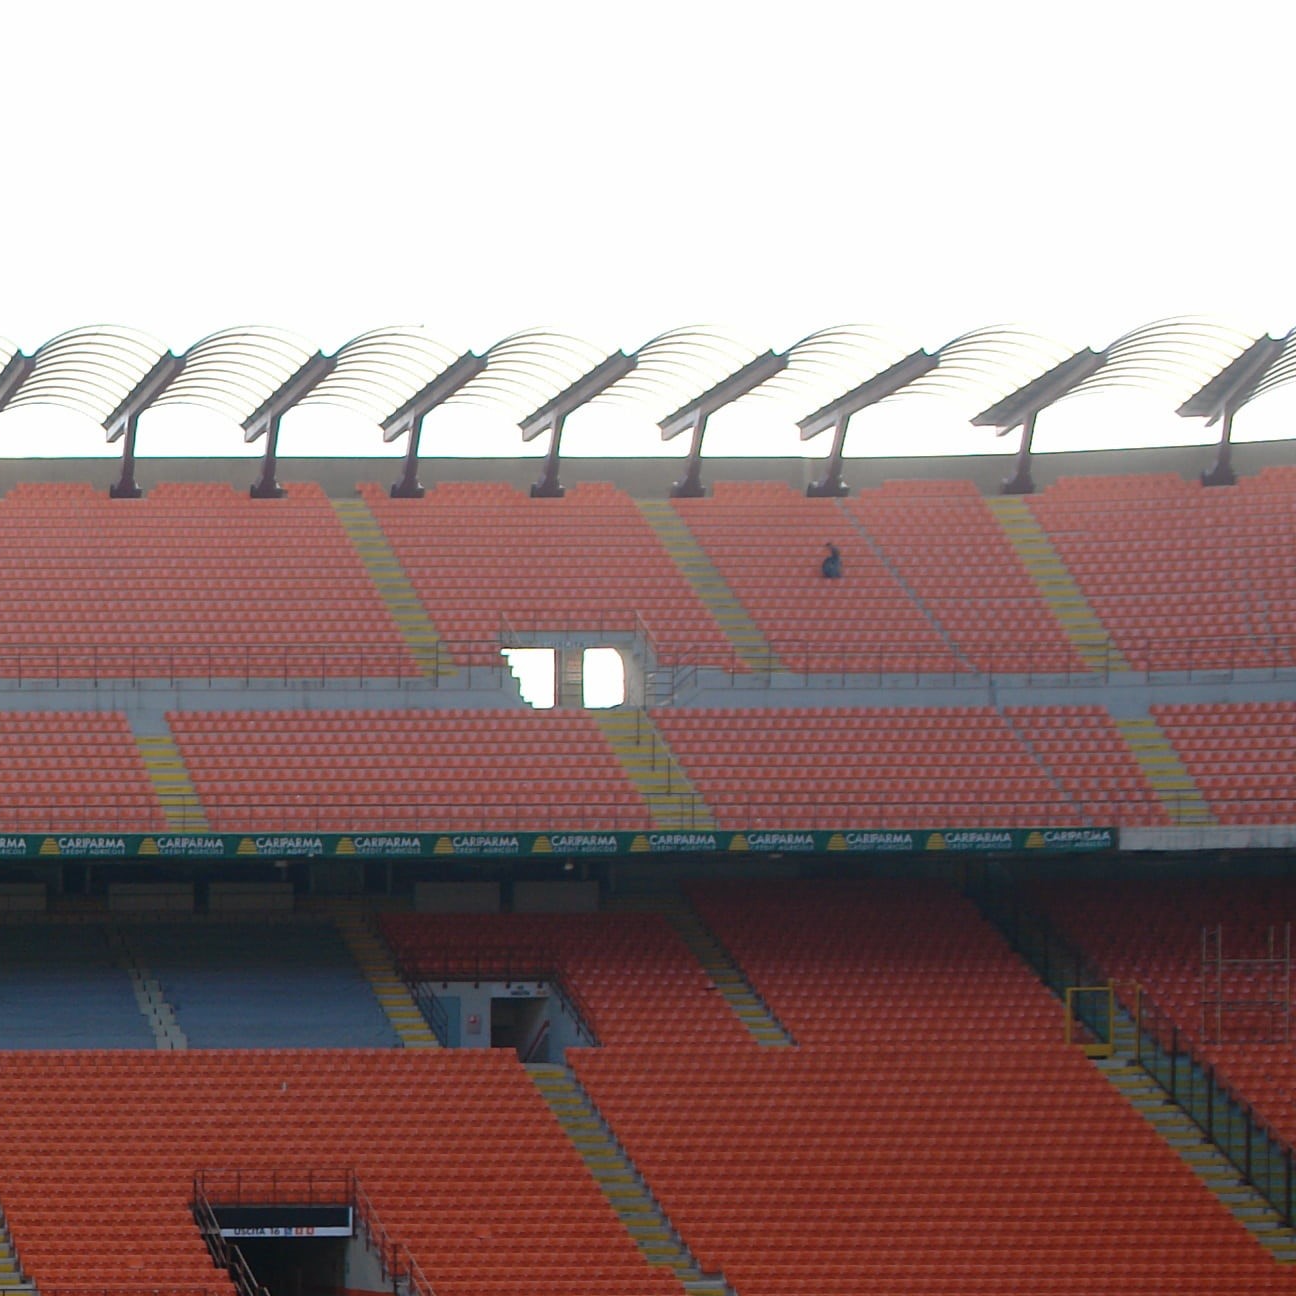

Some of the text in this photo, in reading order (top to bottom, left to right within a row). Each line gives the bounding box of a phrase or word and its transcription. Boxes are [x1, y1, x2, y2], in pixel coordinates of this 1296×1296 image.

[59, 838, 125, 848] CARIPARMA
[158, 838, 224, 848] CARIPARMA
[256, 838, 322, 848] CARIPARMA
[355, 837, 421, 847] CARIPARMA
[453, 837, 519, 847] CARIPARMA
[551, 836, 617, 846] CARIPARMA
[649, 835, 716, 845] CARIPARMA
[748, 835, 814, 844] CARIPARMA
[846, 834, 912, 844] CARIPARMA
[945, 833, 1012, 843] CARIPARMA
